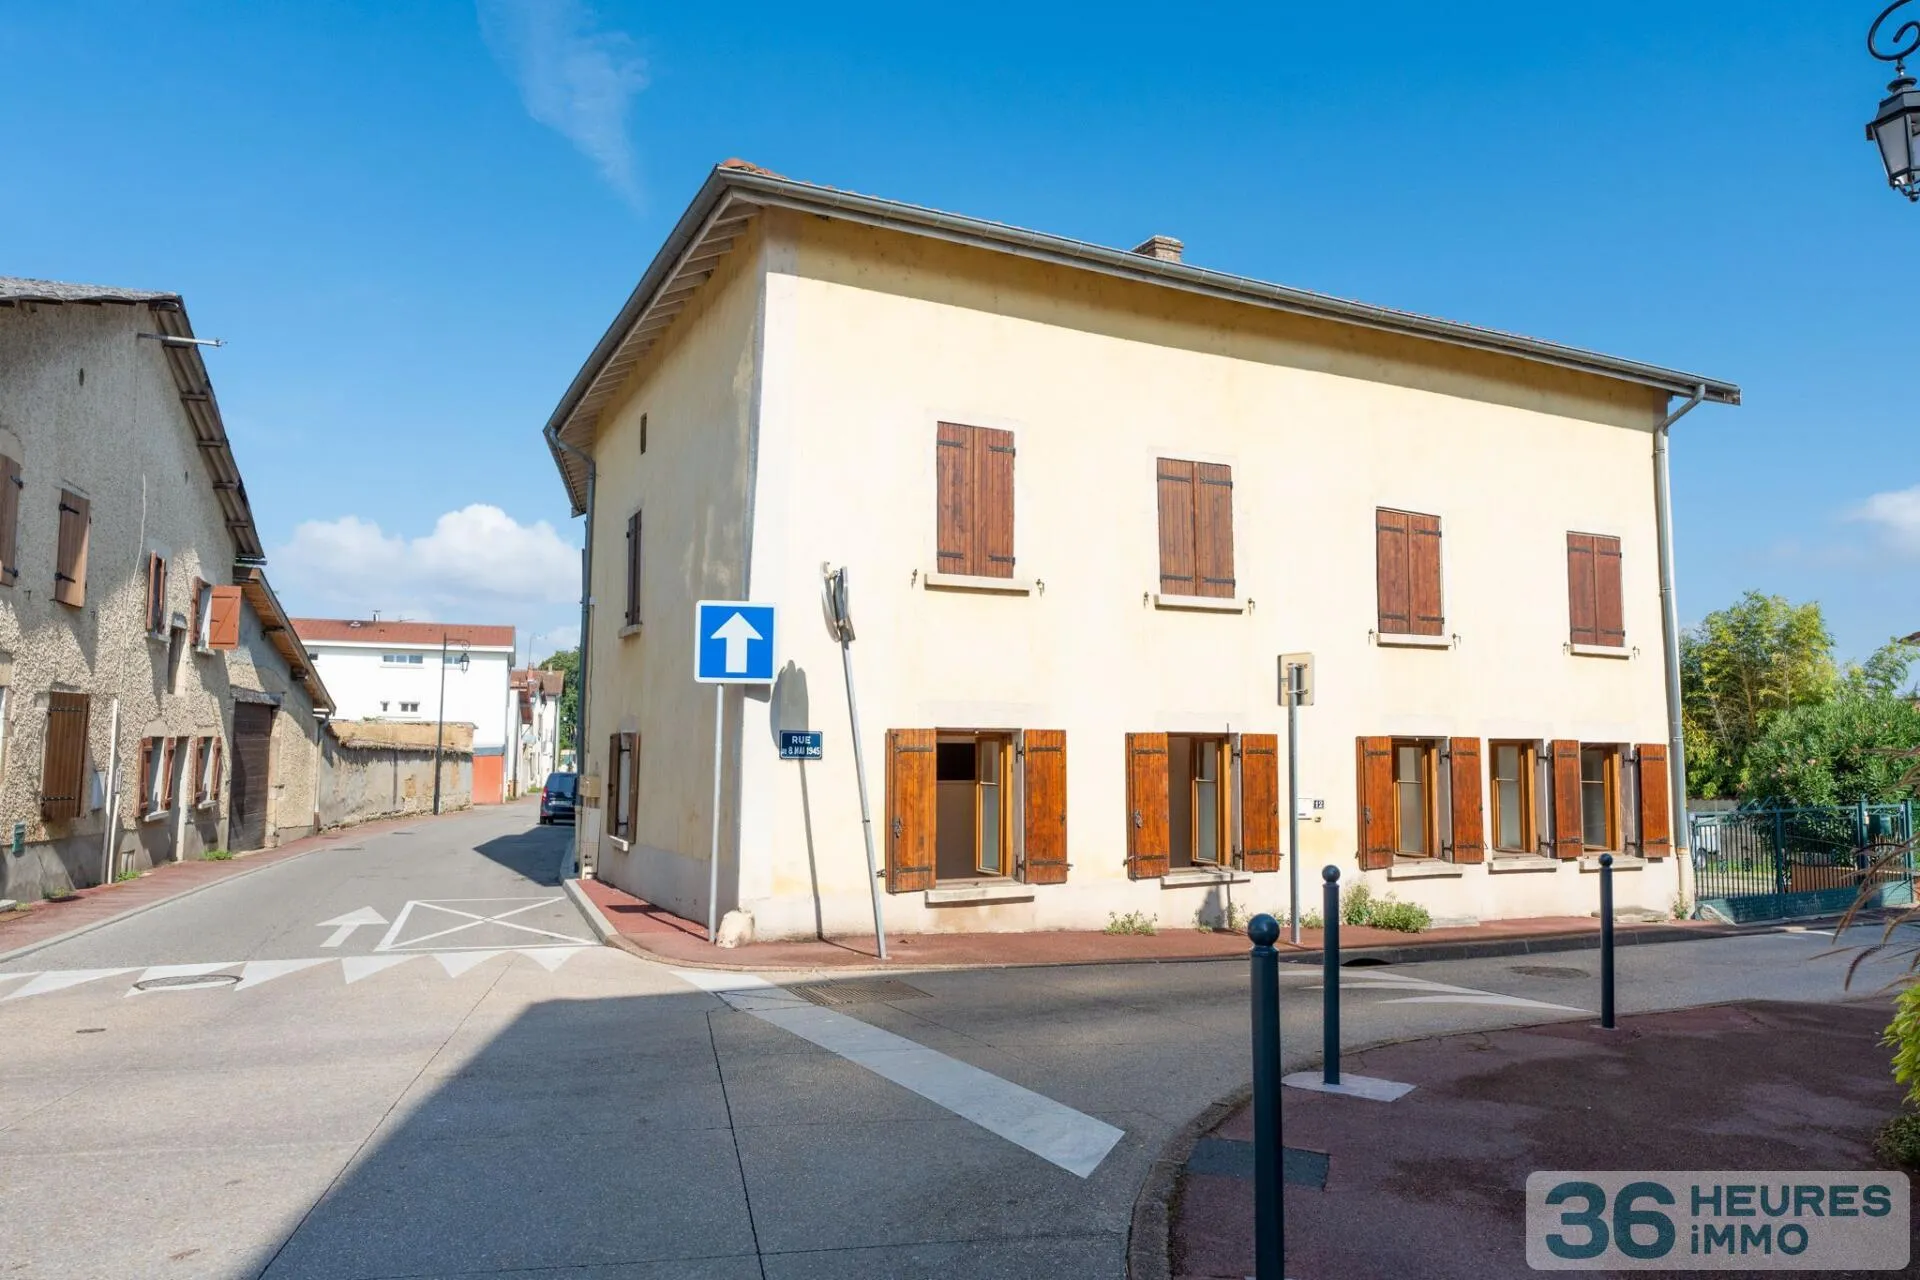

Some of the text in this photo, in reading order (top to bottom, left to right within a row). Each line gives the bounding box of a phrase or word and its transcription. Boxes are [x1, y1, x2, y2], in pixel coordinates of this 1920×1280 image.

[792, 735, 811, 744] RUE
[788, 746, 793, 755] 8
[794, 746, 805, 755] MAI
[806, 747, 820, 755] 1945
